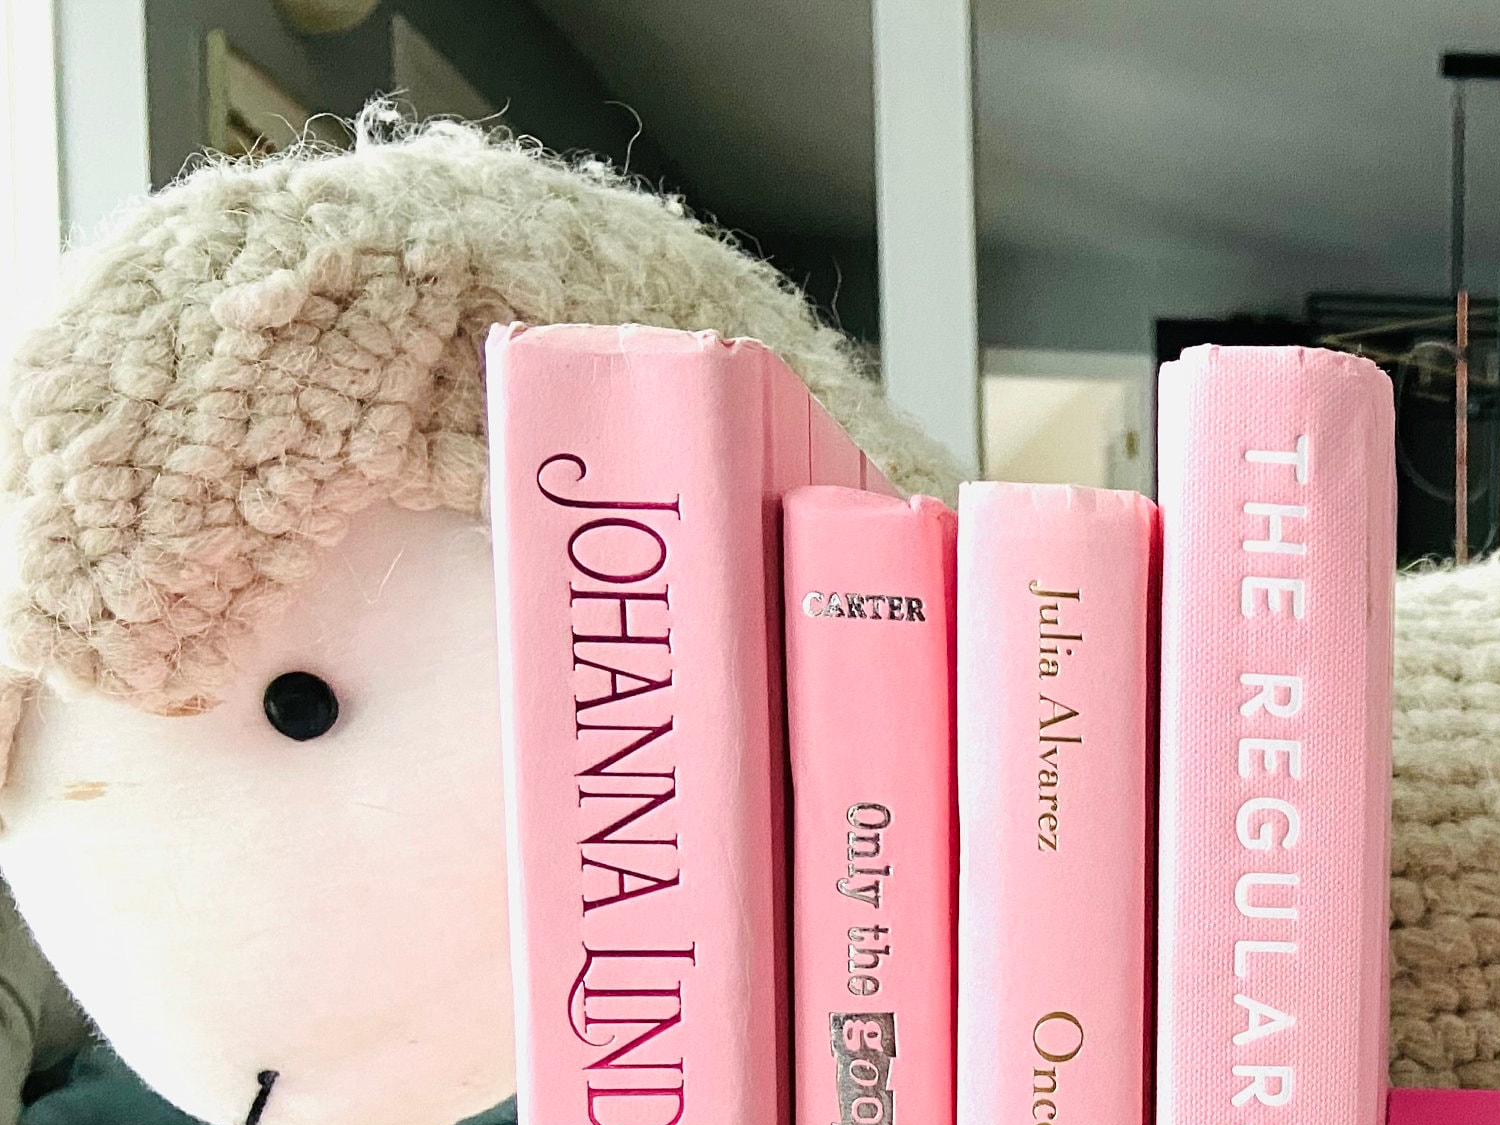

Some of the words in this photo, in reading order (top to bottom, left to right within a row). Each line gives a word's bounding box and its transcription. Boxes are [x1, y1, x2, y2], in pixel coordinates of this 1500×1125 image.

[1240, 435, 1312, 621] THE
[803, 591, 925, 621] CARTER
[1029, 579, 1084, 680] Julia
[537, 453, 681, 918] JOHANNA
[1037, 695, 1083, 853] Alvarez
[837, 802, 890, 909] Only
[847, 925, 889, 997] the
